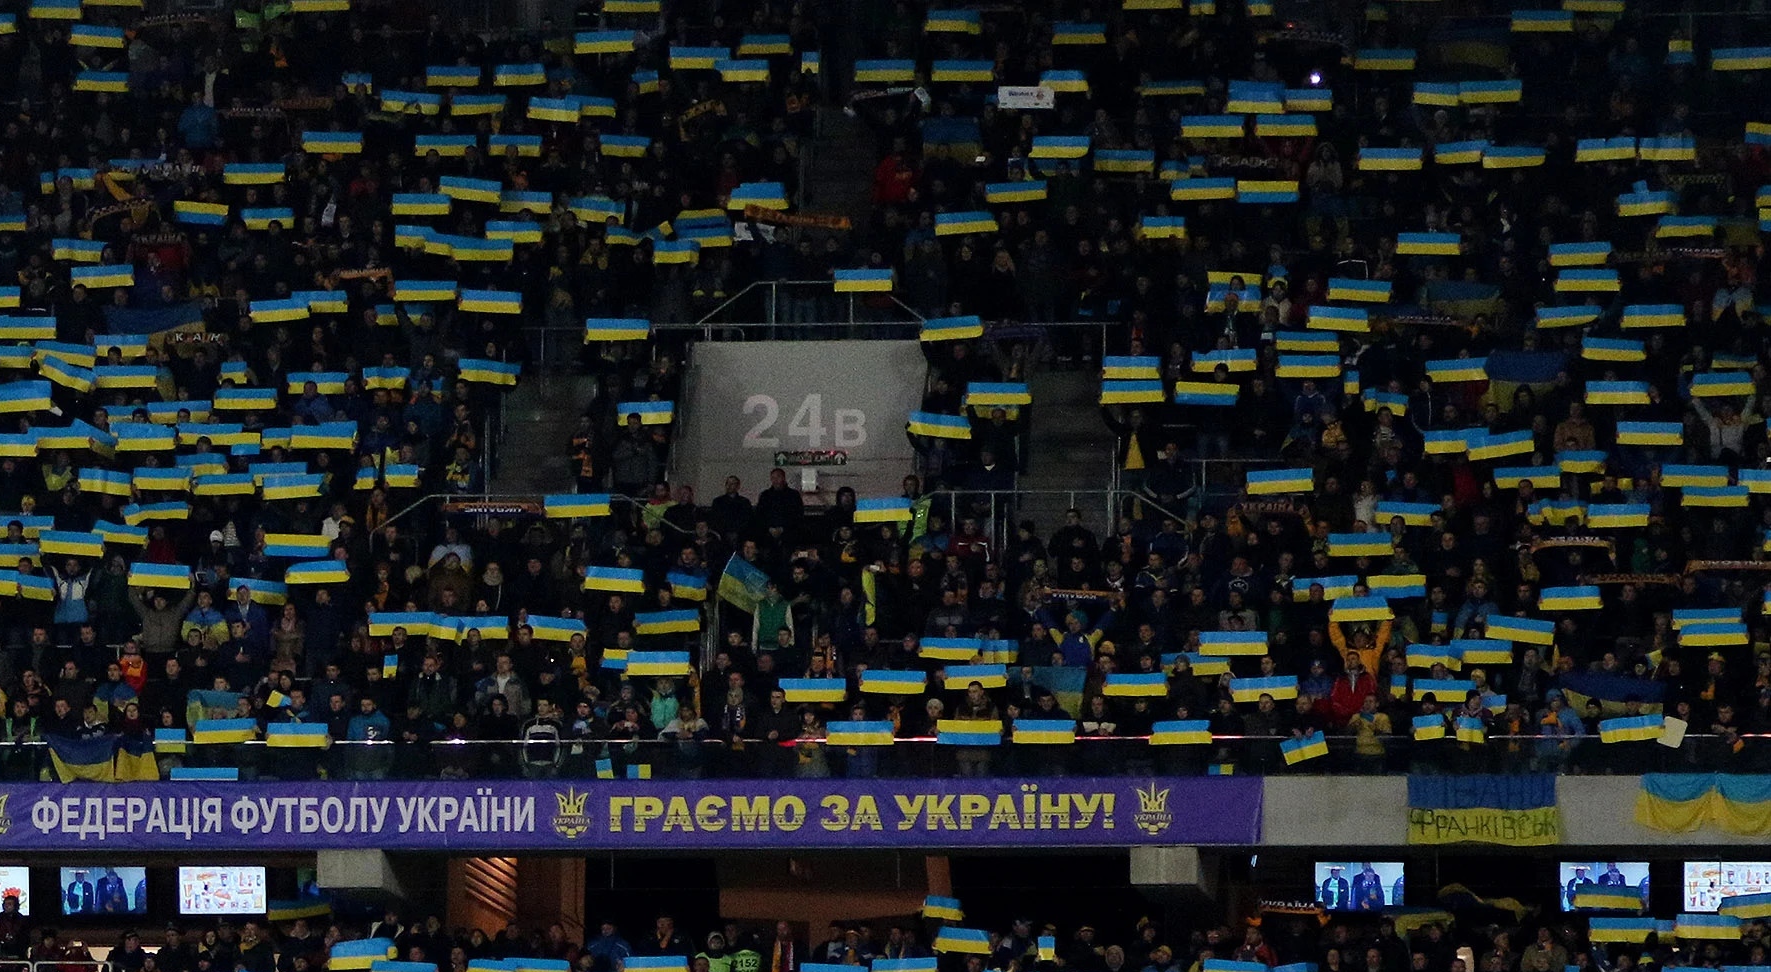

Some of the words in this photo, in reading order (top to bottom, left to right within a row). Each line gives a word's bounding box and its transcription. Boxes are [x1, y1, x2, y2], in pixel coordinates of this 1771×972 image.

[1240, 502, 1295, 512] УКРАЇНА
[610, 794, 807, 833] ГРАЄМО
[820, 794, 884, 831] ЗА
[895, 783, 1116, 831] УКРАЇНУ!
[32, 795, 223, 840] ФЕДЕРАЦІЯ
[231, 794, 390, 836] ФУТБОЛУ
[396, 787, 535, 834] УКРАЇНИ
[1134, 813, 1172, 822] УКРАЇНА
[553, 816, 591, 825] УКРАЇНА
